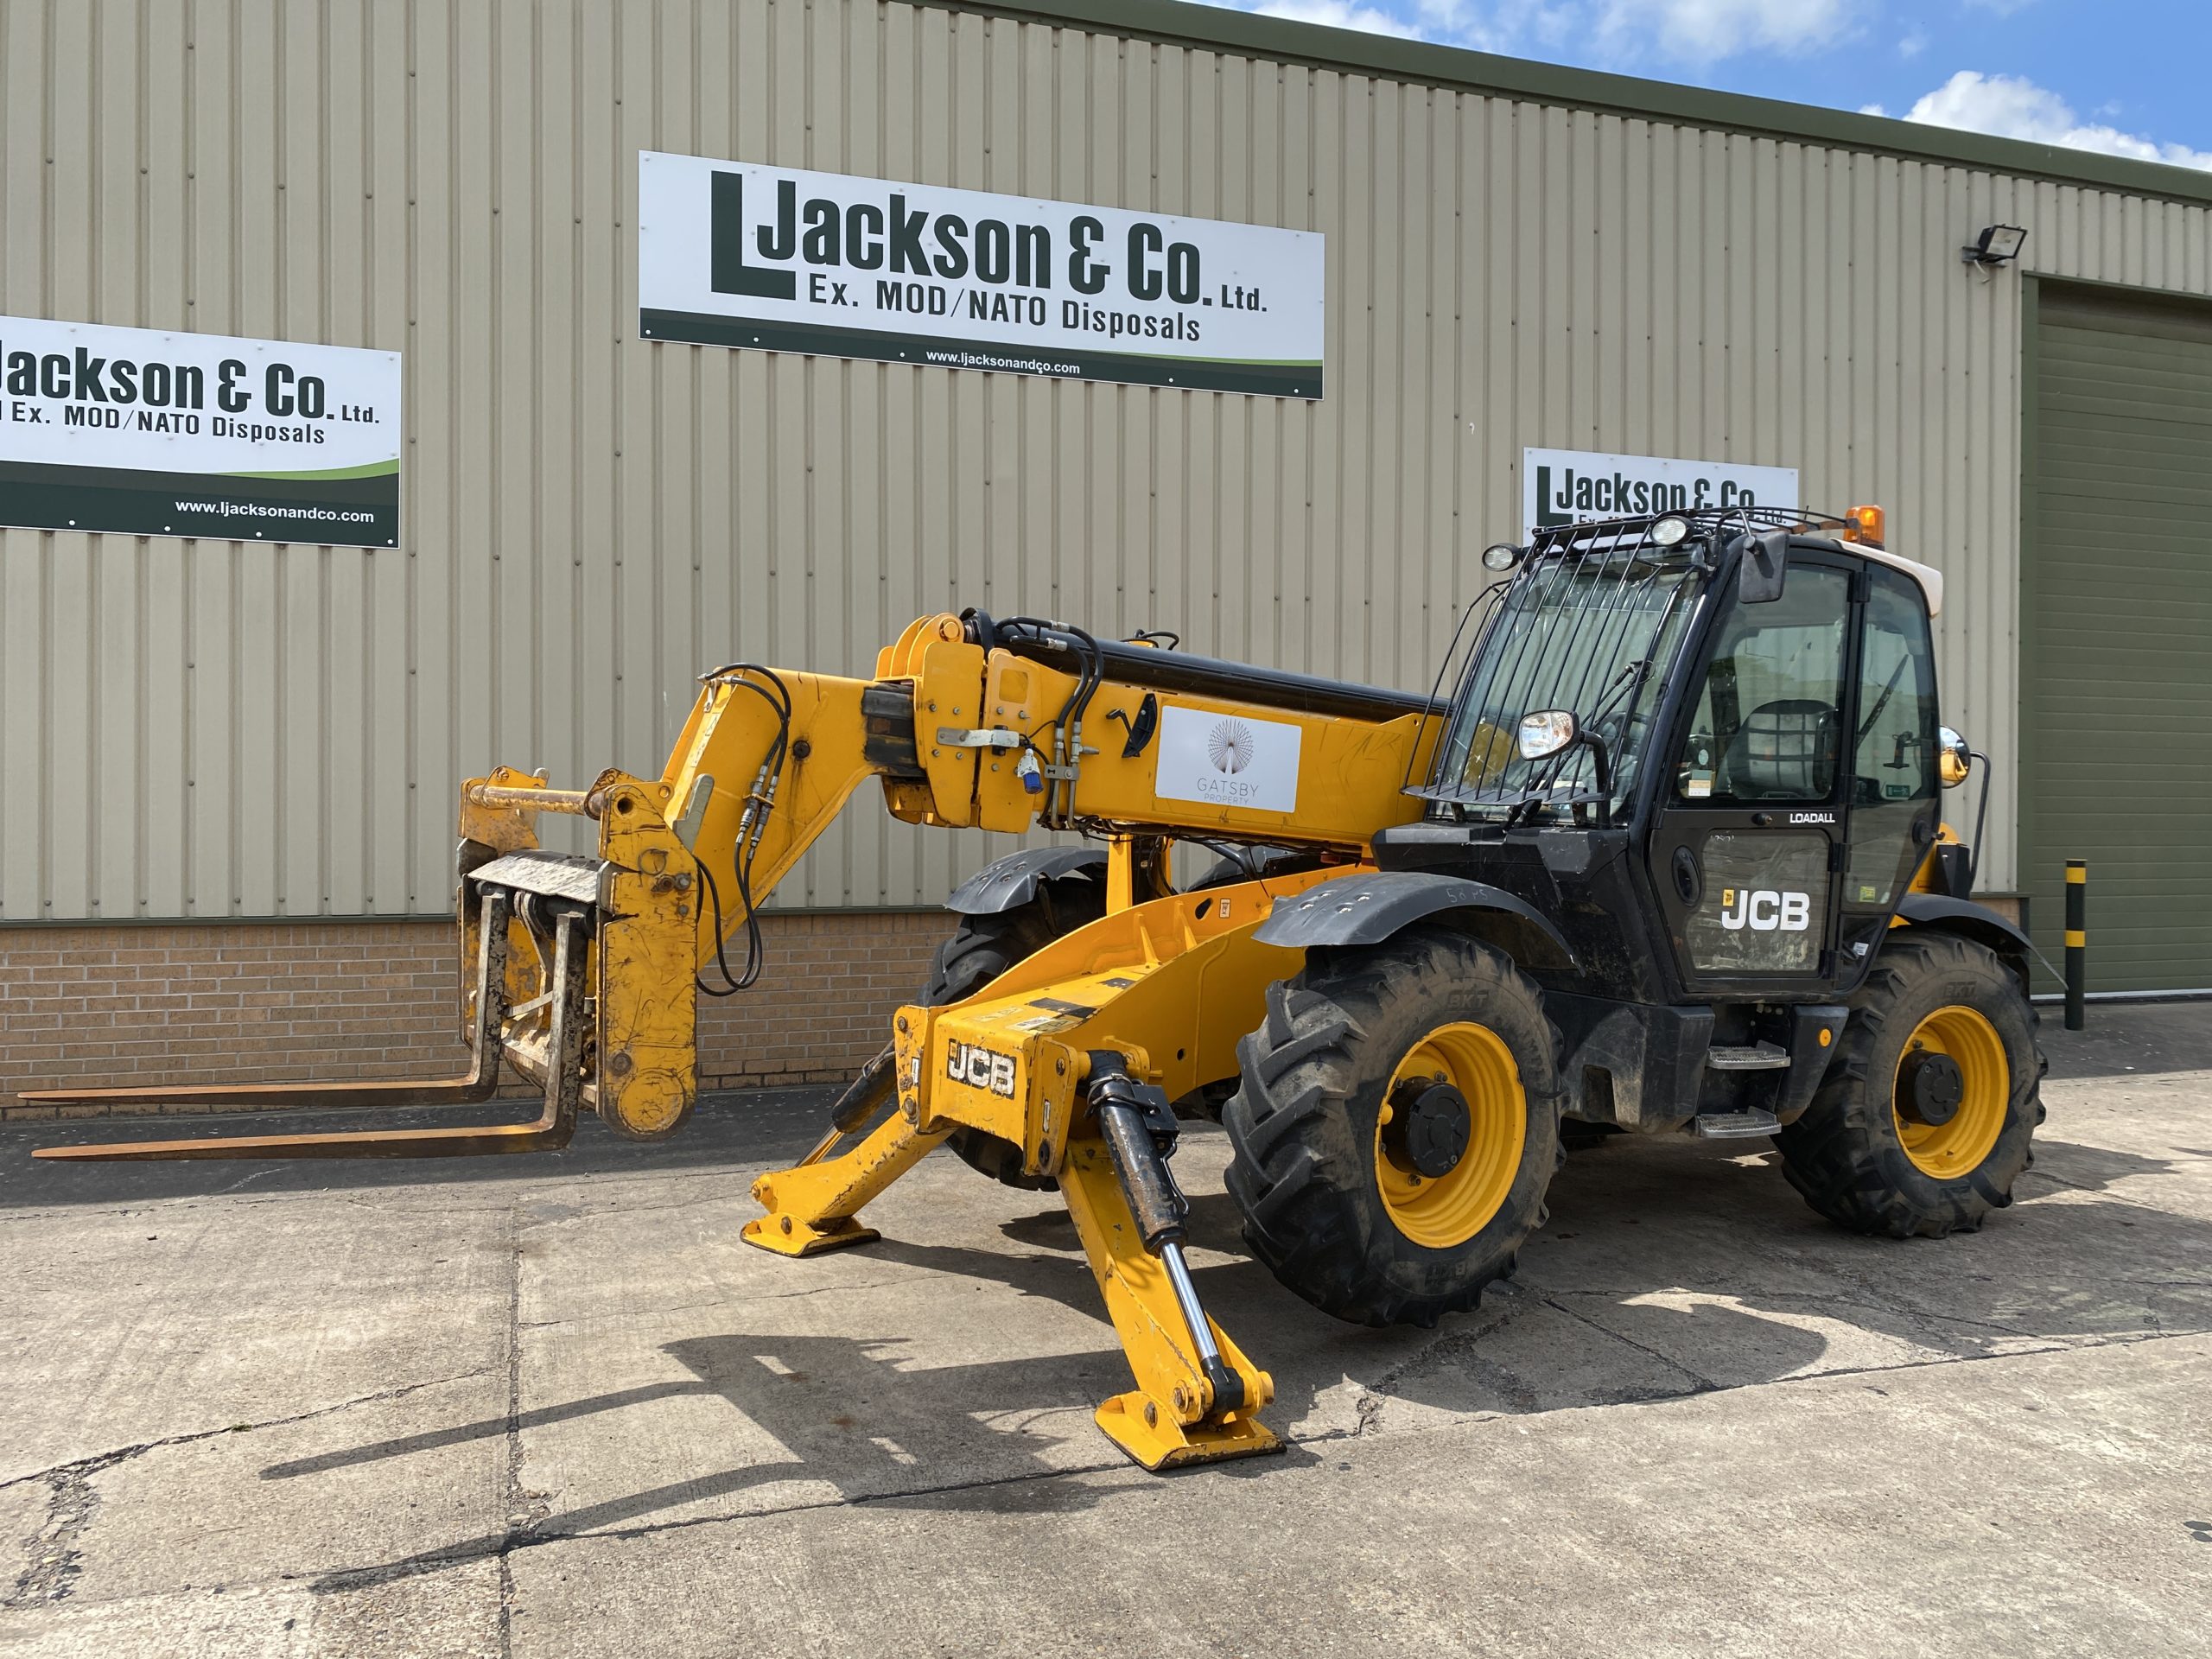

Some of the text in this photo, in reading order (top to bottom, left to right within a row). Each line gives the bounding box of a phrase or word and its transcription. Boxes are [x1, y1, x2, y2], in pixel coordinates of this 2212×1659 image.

[1069, 216, 1110, 295] &
[1128, 222, 1211, 306] Co.
[1221, 284, 1268, 312] Ltd.
[810, 273, 1200, 341] Ex. MOD/NATO Disposals
[926, 351, 1080, 375] www.ljacksonandco.com
[0, 340, 380, 423] ackson & Co. Ltd.
[12, 401, 325, 444] Ex. MOD/NATO Disposals
[1694, 478, 1713, 508] &
[175, 501, 375, 523] www.ljacksonandco.com
[1197, 778, 1260, 798] GATSBY
[1205, 793, 1249, 805] PROPERTY
[1789, 813, 1835, 823] LOADALL
[1721, 889, 1810, 931] JCB
[948, 1041, 1015, 1096] JCB
